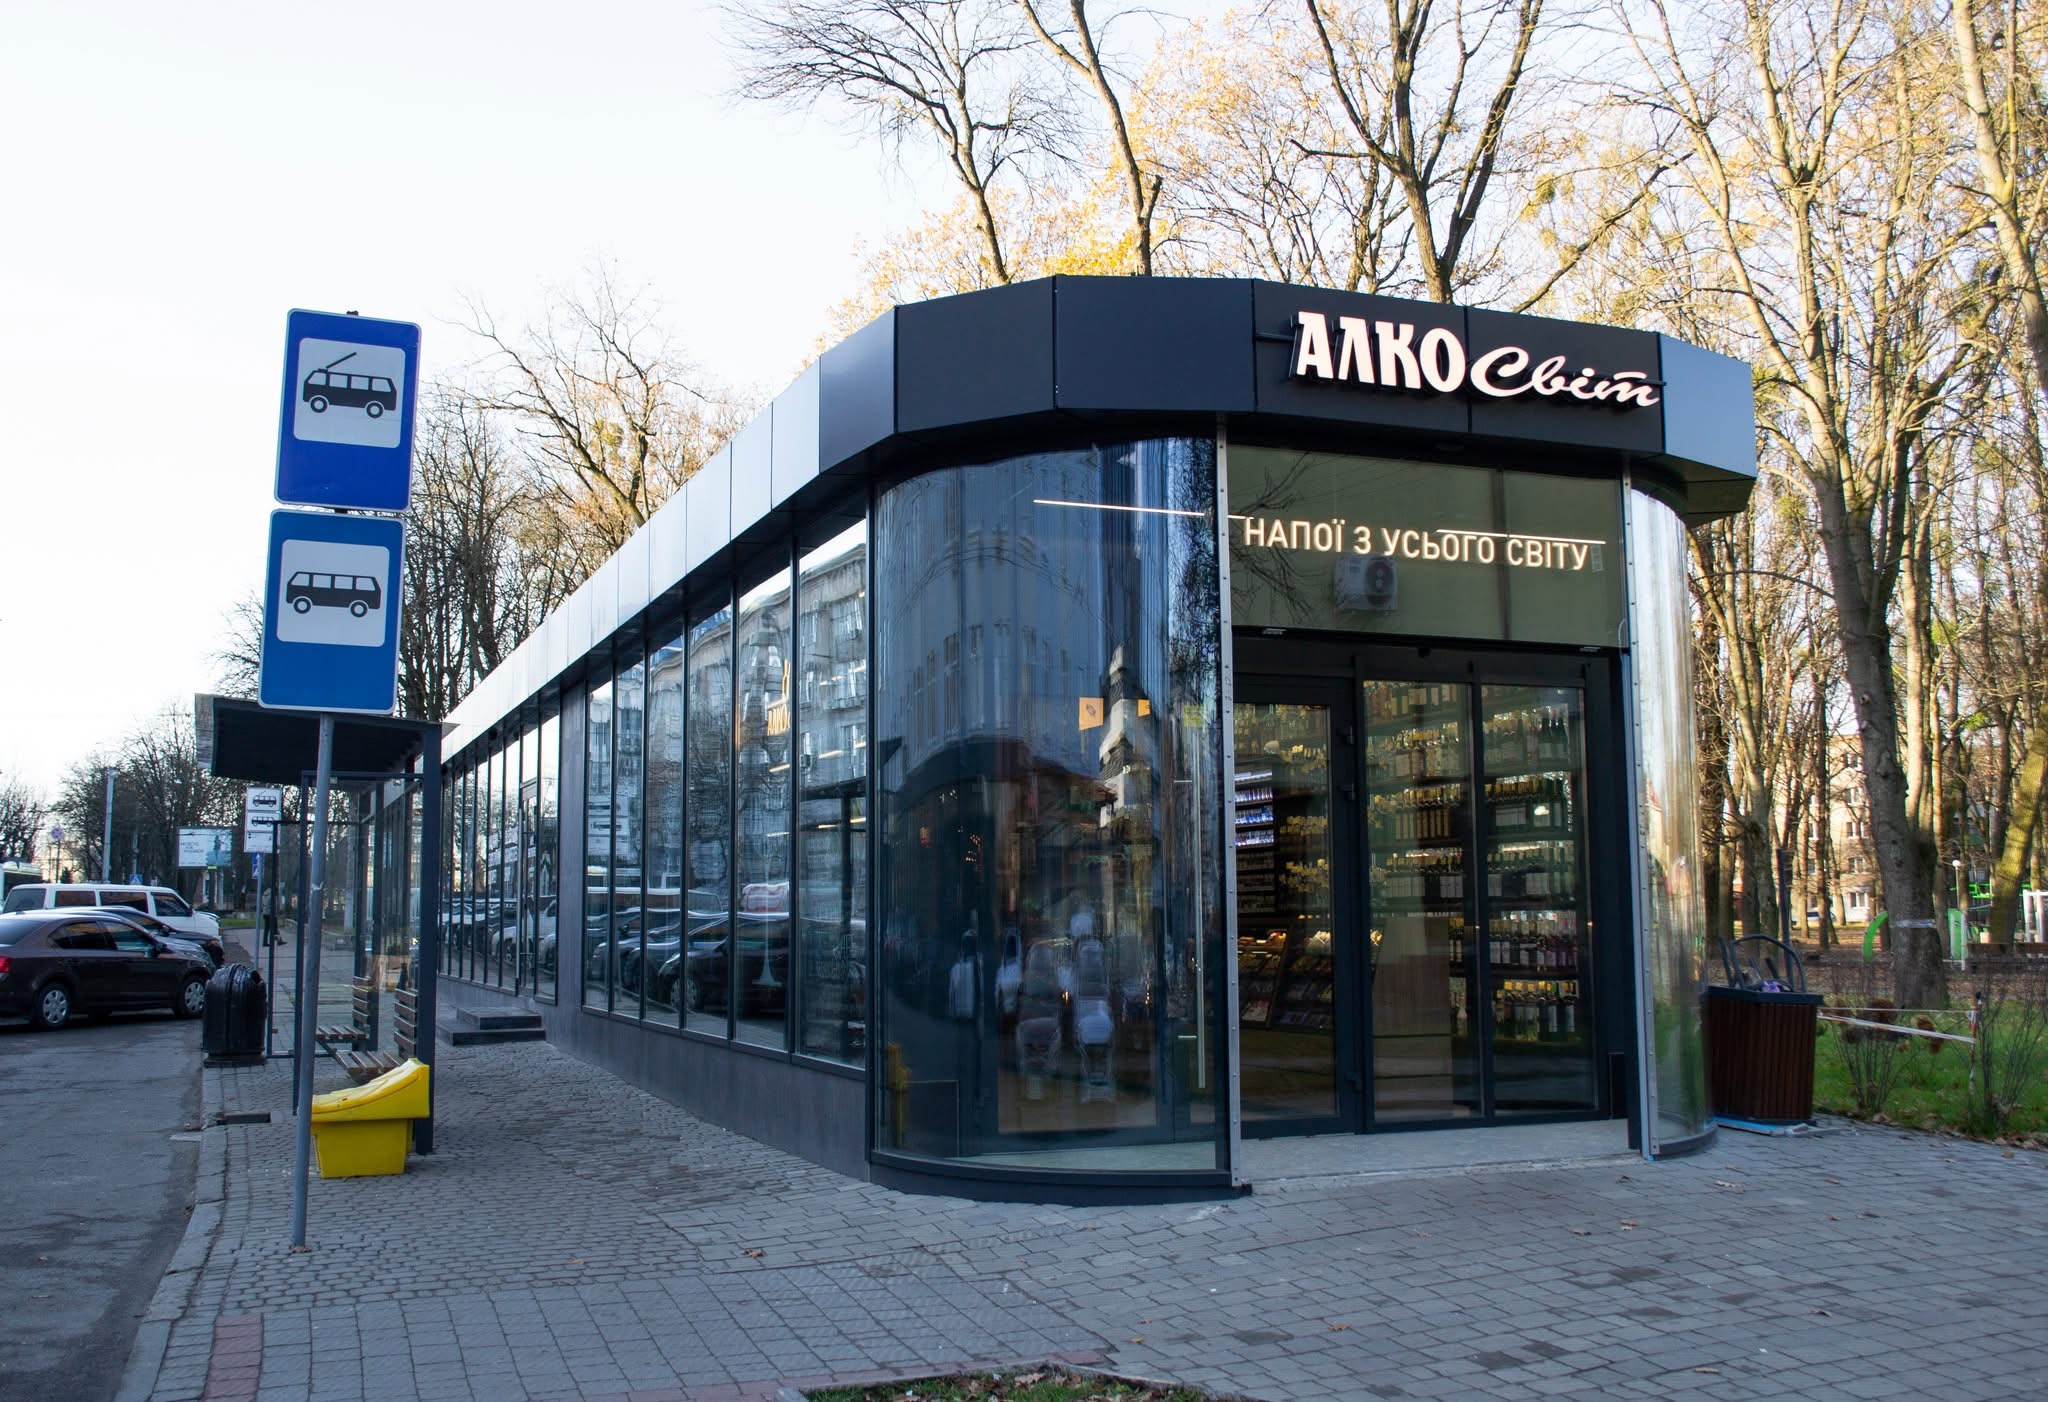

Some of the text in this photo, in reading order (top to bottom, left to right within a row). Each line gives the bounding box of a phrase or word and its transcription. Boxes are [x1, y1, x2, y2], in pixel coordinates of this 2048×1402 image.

[1295, 311, 1660, 407] АЛКО Світ
[1243, 517, 1589, 570] НАПОЇ З УСЬОГО СВІТУ
